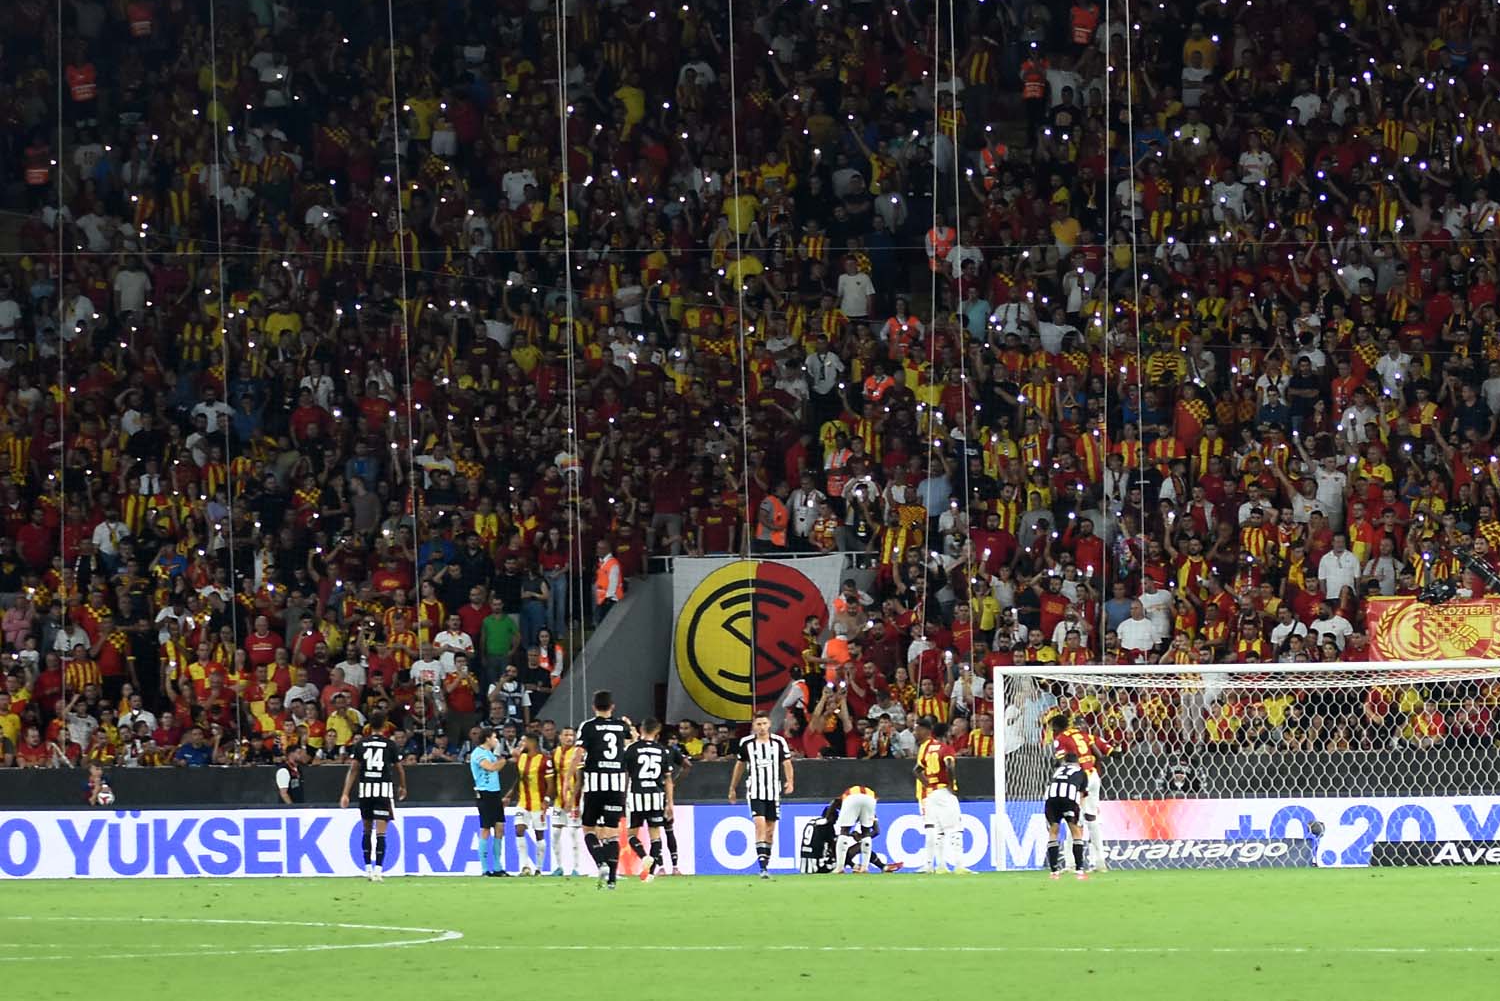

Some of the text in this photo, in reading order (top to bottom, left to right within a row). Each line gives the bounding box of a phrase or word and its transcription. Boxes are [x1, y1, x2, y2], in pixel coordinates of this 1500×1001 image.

[602, 732, 619, 760] 3
[1071, 732, 1089, 755] 5
[362, 747, 385, 771] 14
[637, 754, 663, 779] 25
[56, 810, 336, 877] YÜKSEK
[350, 814, 551, 874] ORAN
[802, 824, 815, 847] 9
